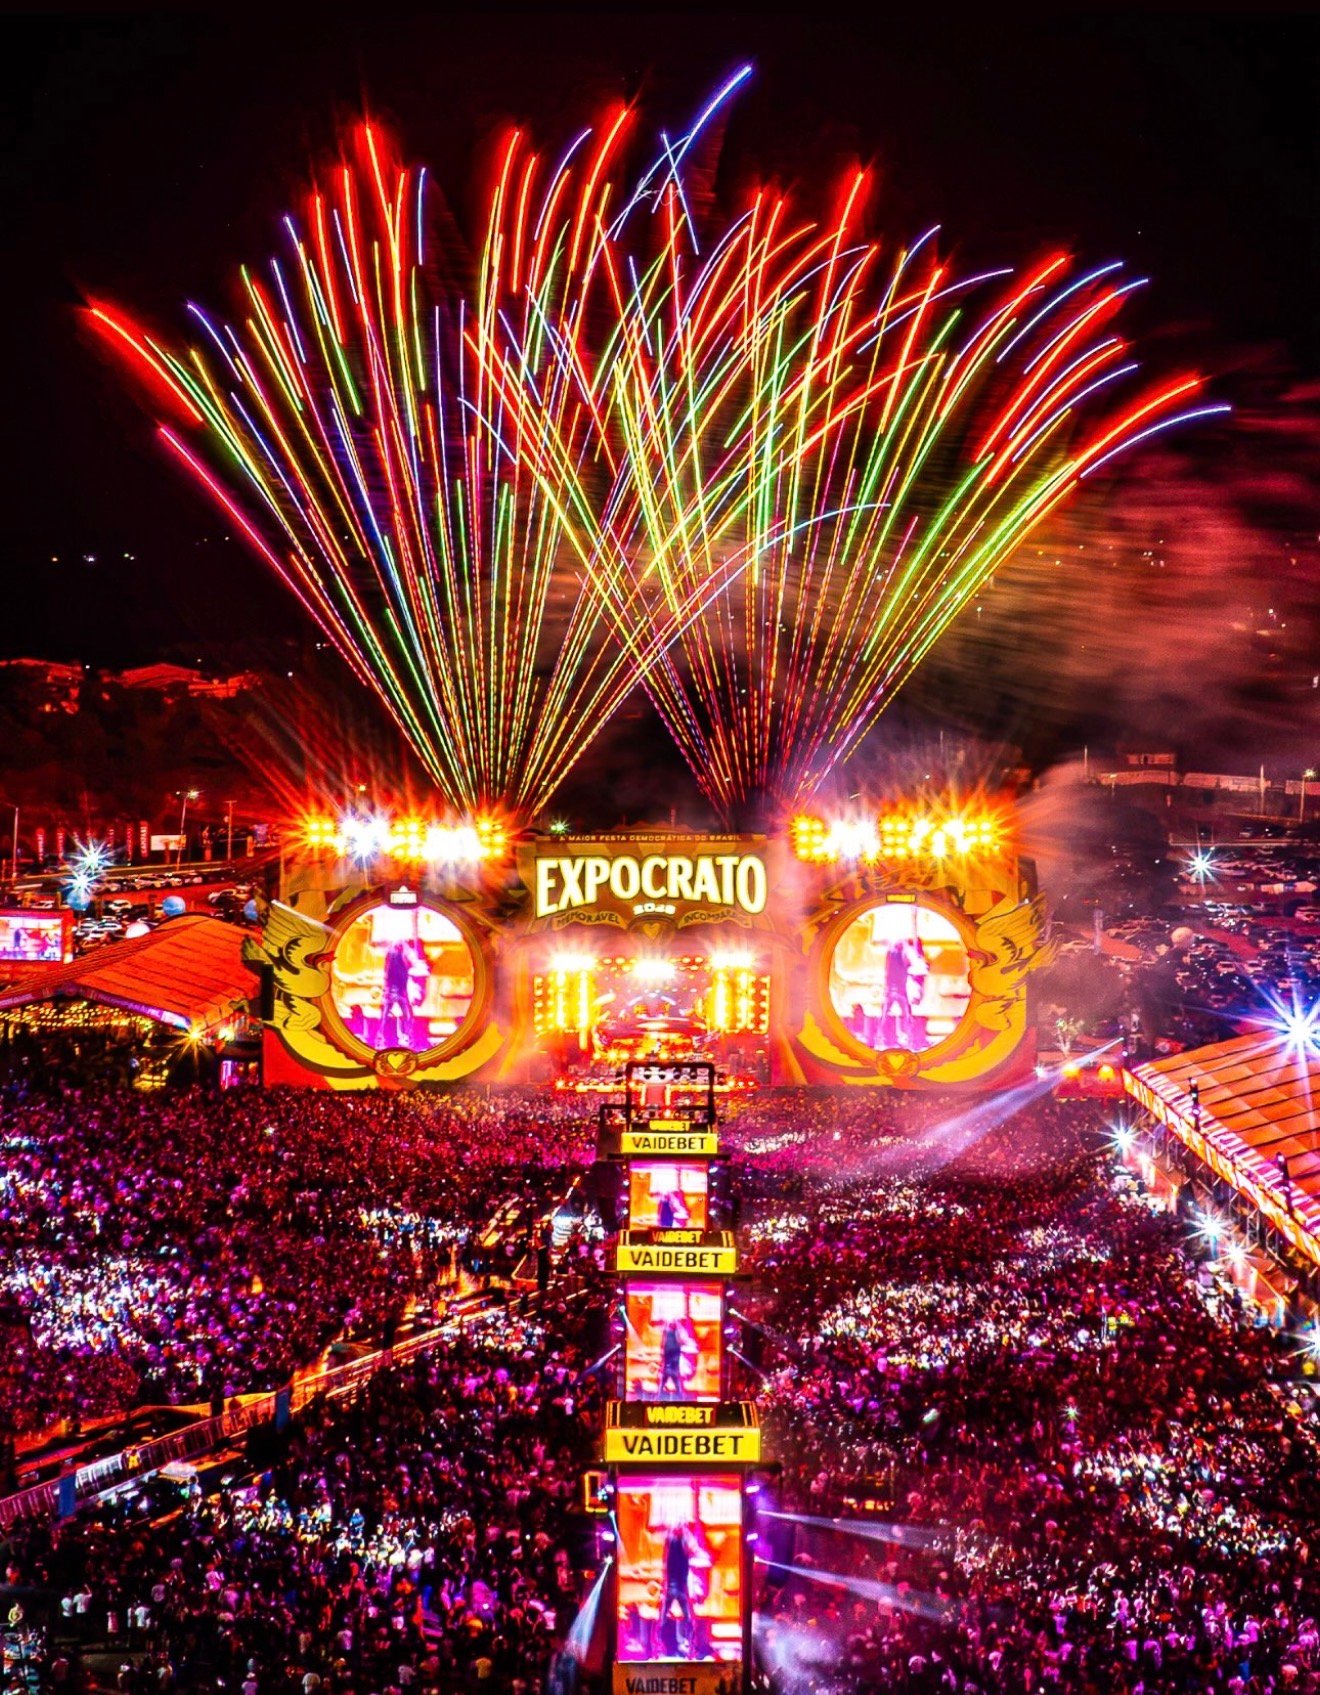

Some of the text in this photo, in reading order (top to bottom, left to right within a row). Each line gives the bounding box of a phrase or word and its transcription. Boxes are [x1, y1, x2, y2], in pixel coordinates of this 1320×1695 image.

[536, 855, 768, 918] EXPOCRATO
[631, 1136, 707, 1150] VAIDEBET
[630, 1250, 723, 1268] VAIDEBET
[646, 1406, 714, 1424] VAIDEBET
[622, 1435, 744, 1455] VAIDEBET
[625, 1677, 697, 1694] VAIDEBET
